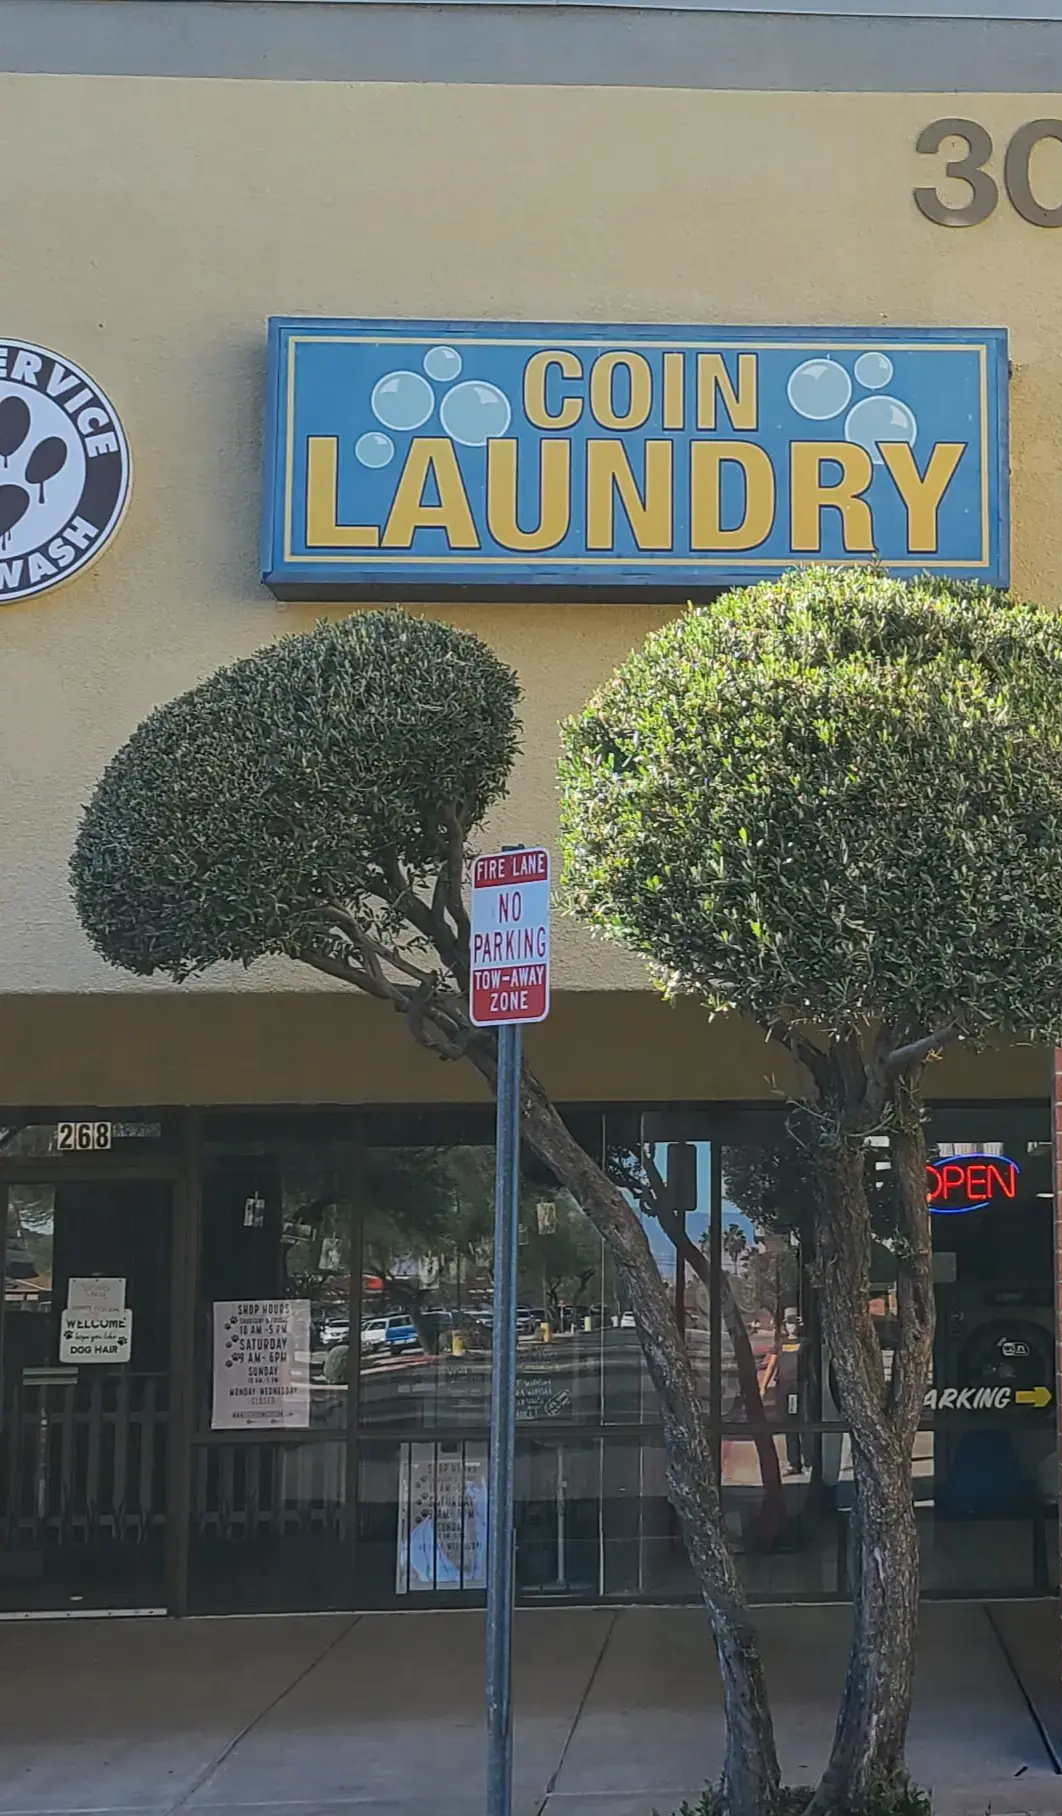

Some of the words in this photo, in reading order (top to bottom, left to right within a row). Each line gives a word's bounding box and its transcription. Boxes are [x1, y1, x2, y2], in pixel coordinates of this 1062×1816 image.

[523, 349, 759, 431] COIN
[305, 434, 969, 553] LAUNDRY
[0, 515, 100, 590] WASH
[477, 858, 505, 881] FIRE
[512, 853, 546, 877] LANE
[499, 891, 522, 924] NO
[473, 926, 546, 964] PARKING
[474, 965, 545, 990] TOW-AWAY
[490, 990, 529, 1012] ZONE
[59, 1123, 109, 1149] 268
[925, 1163, 1016, 1201] OPEN
[238, 1303, 260, 1315] SHOP
[66, 1319, 126, 1329] WELCOME
[70, 1346, 92, 1354] DOG
[94, 1345, 118, 1354] HAIR
[240, 1337, 288, 1350] SATURDAY
[248, 1366, 278, 1376] SUNDAY
[923, 1387, 1012, 1409] ARKING
